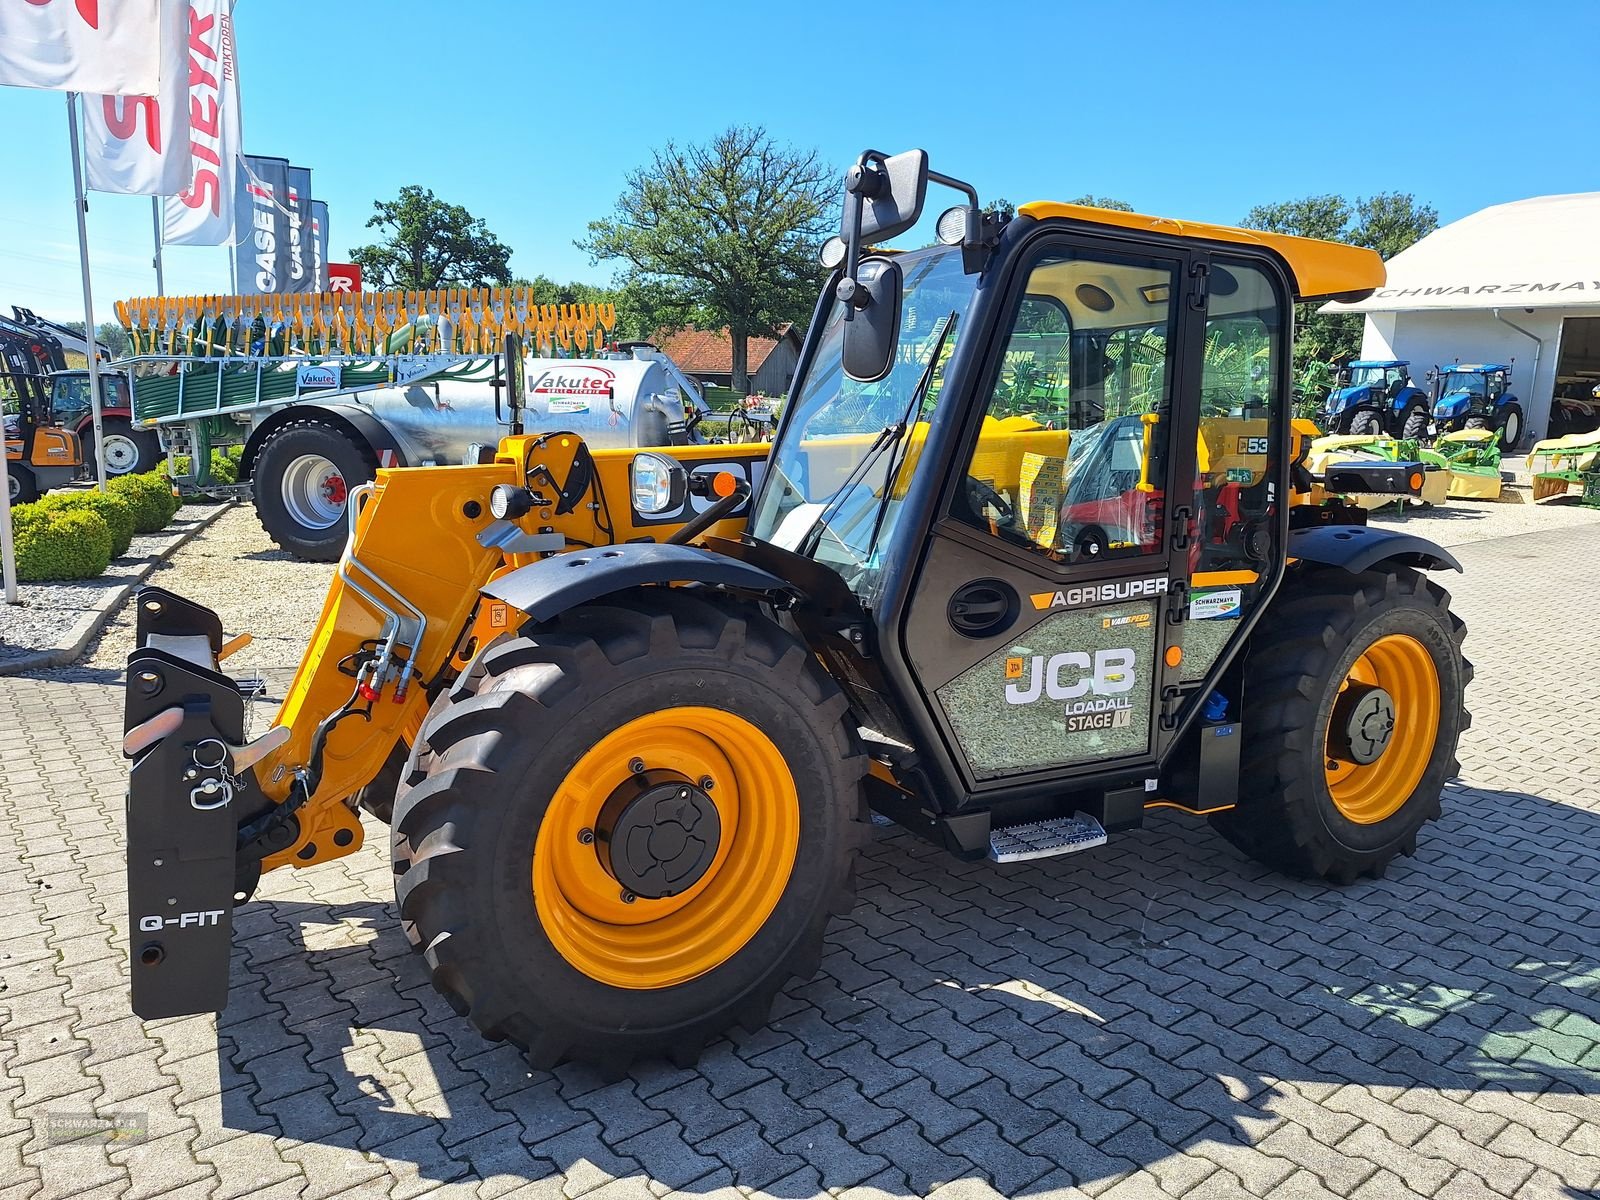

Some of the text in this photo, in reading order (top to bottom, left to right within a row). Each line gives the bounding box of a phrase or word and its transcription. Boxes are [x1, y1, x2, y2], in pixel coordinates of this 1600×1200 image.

[221, 13, 233, 82] TRAKTOREN
[255, 208, 277, 293] CASE
[1376, 280, 1600, 298] CHWARZMA
[301, 372, 336, 384] Vakutec
[528, 371, 615, 393] Vakutec
[1050, 577, 1168, 608] AGRISUPER
[1195, 596, 1234, 606] SCHWARZMAYR
[1005, 648, 1136, 704] JCB
[1065, 697, 1133, 716] LOADALL
[1068, 712, 1112, 731] STAGE
[140, 910, 225, 932] Q-FIT
